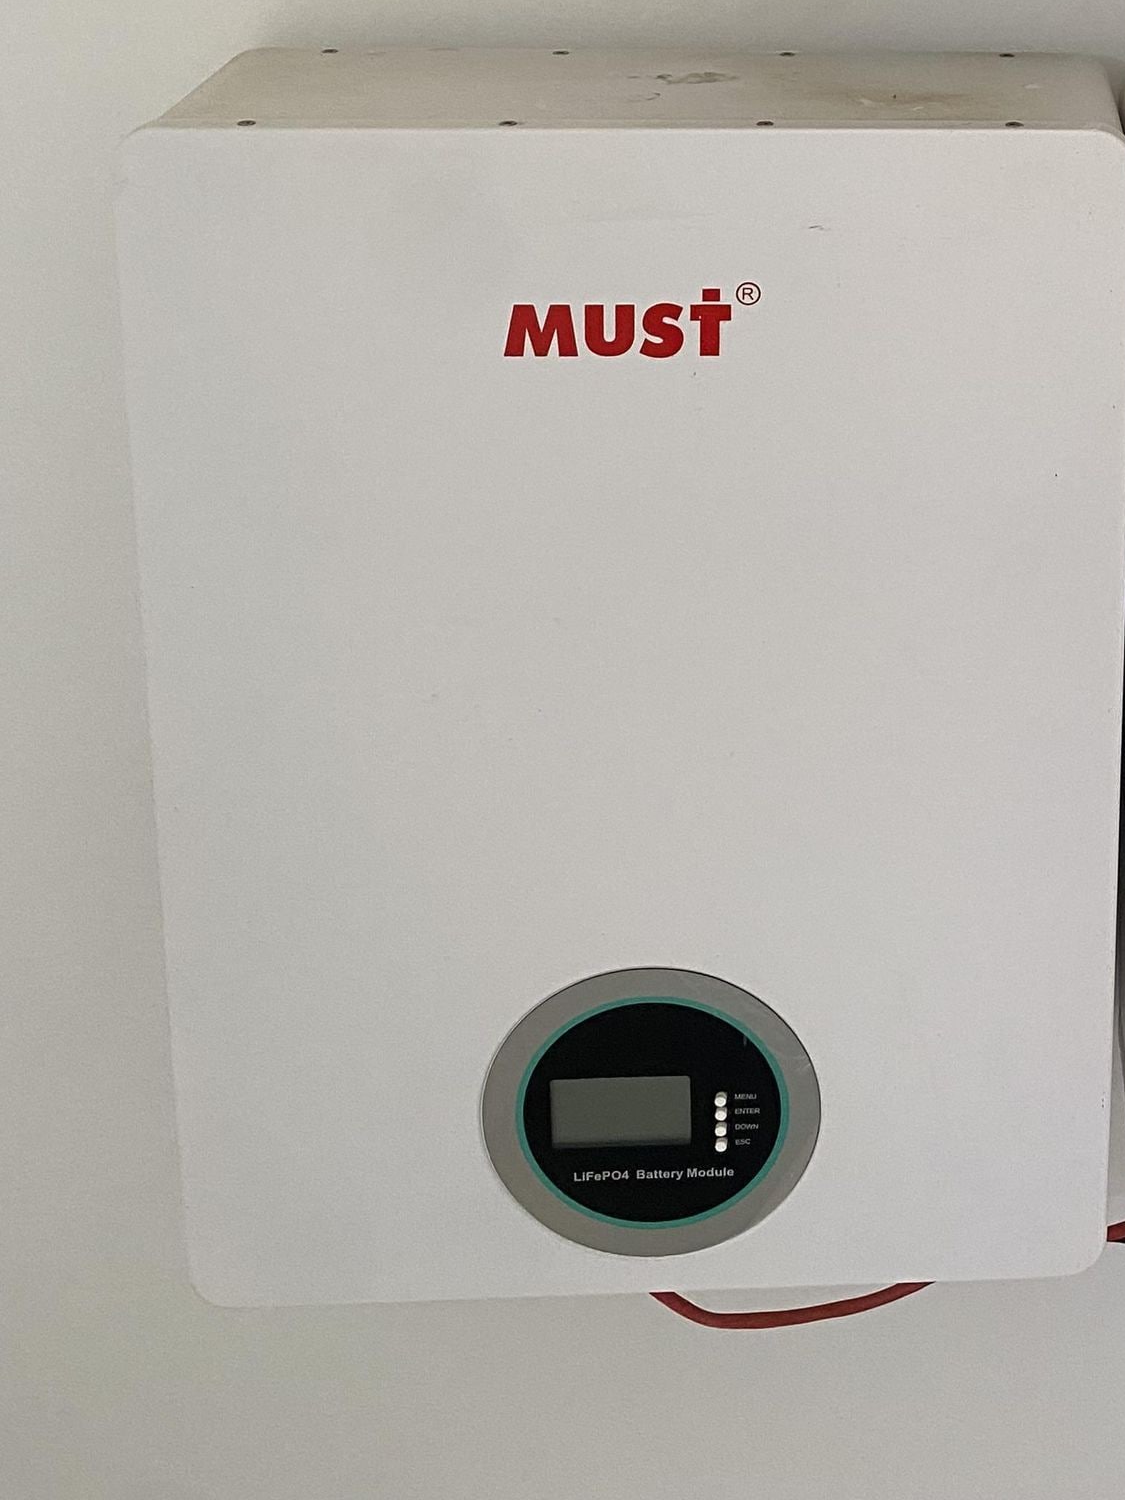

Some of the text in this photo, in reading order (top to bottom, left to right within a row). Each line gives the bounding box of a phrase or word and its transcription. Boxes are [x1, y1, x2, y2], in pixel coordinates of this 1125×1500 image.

[503, 288, 732, 358] MUST
[573, 1167, 735, 1182] LiFePO4 Battery Module
